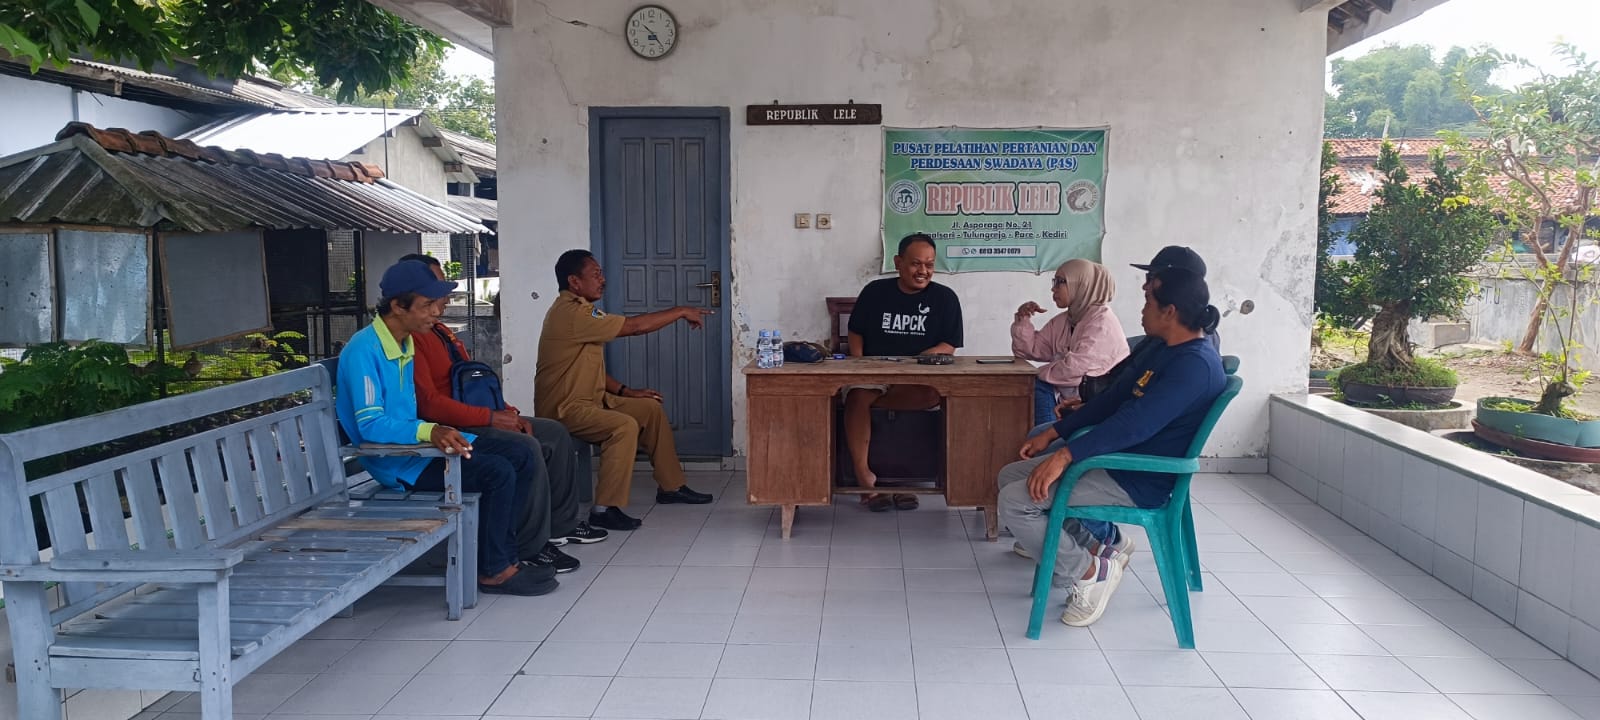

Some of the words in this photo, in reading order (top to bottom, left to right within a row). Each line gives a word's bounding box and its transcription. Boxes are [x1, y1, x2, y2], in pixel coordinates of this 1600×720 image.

[766, 109, 819, 121] REPUBLIK
[833, 109, 857, 120] LELE
[893, 142, 931, 155] PUSAT
[934, 142, 999, 155] PELATIHAN
[1002, 142, 1068, 155] PERTANIAN
[1070, 142, 1097, 155] DAN
[910, 158, 983, 170] PERDESAAN
[984, 158, 1043, 170] SWADAYA
[1046, 158, 1079, 172] (P4S)
[926, 183, 1016, 214] REPUBLIK
[1018, 183, 1060, 214] LELE
[1005, 221, 1020, 229] No.
[1014, 231, 1034, 239] Pare
[1042, 230, 1067, 239] Kediri
[892, 313, 927, 332] APCK
